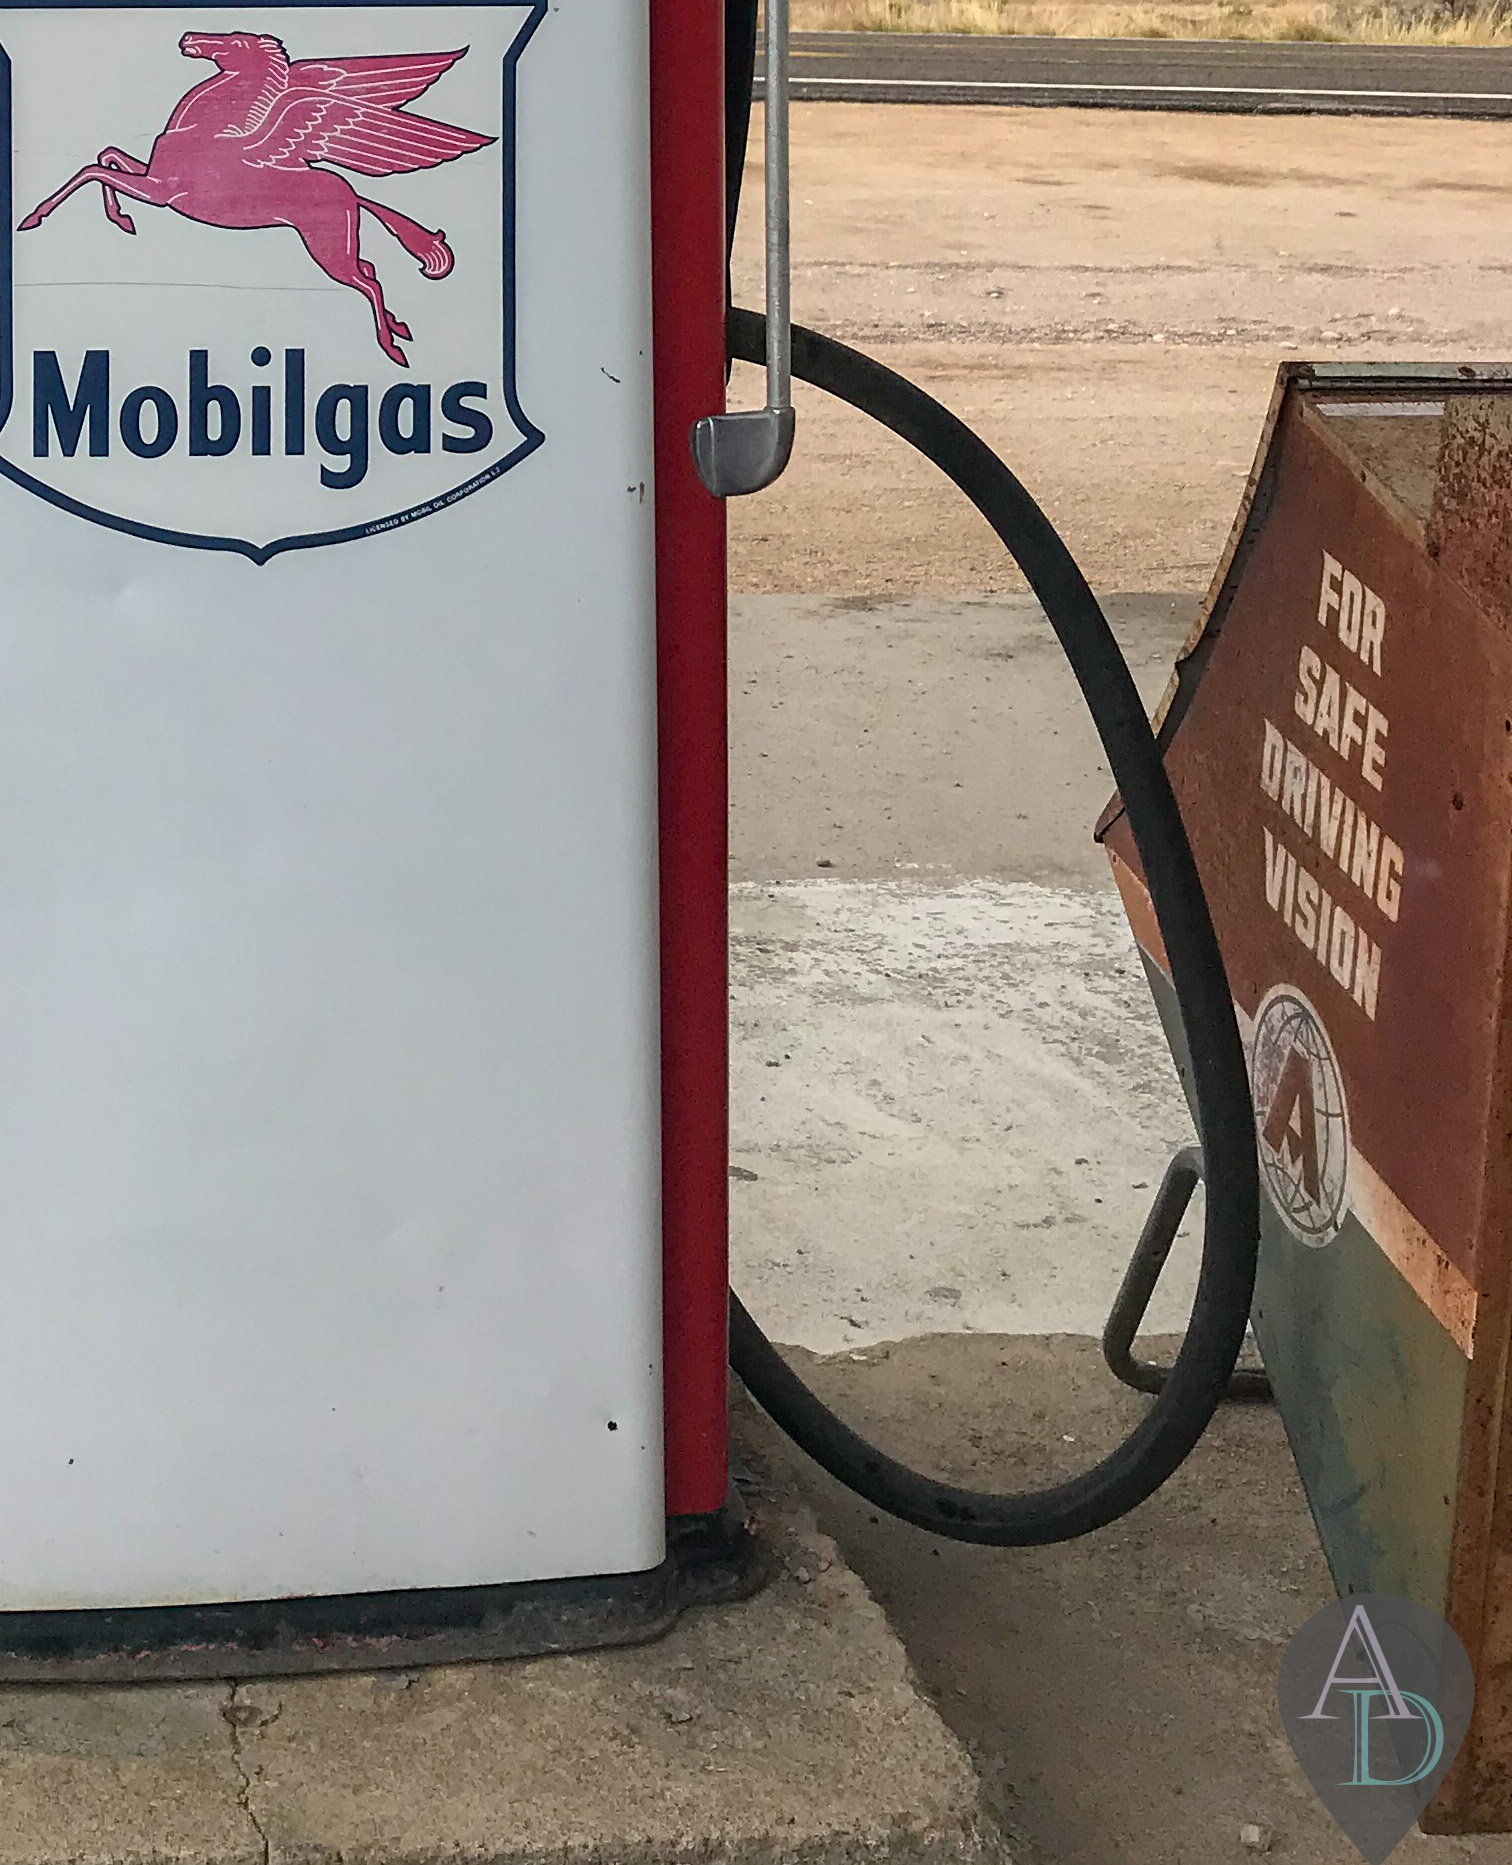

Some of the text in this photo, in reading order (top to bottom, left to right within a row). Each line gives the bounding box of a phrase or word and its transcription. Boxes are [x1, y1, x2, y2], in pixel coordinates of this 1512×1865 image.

[32, 345, 494, 490] Mobilgas
[365, 518, 400, 534] LICENSED
[400, 514, 409, 523] BY
[410, 505, 433, 518] MOBIL
[433, 500, 445, 509] OIL
[446, 473, 491, 503] CORPORATION
[1317, 548, 1386, 677] FOR
[1294, 644, 1389, 792] SAFE
[1259, 717, 1405, 923] DRIVING
[1262, 824, 1381, 1023] VISION
